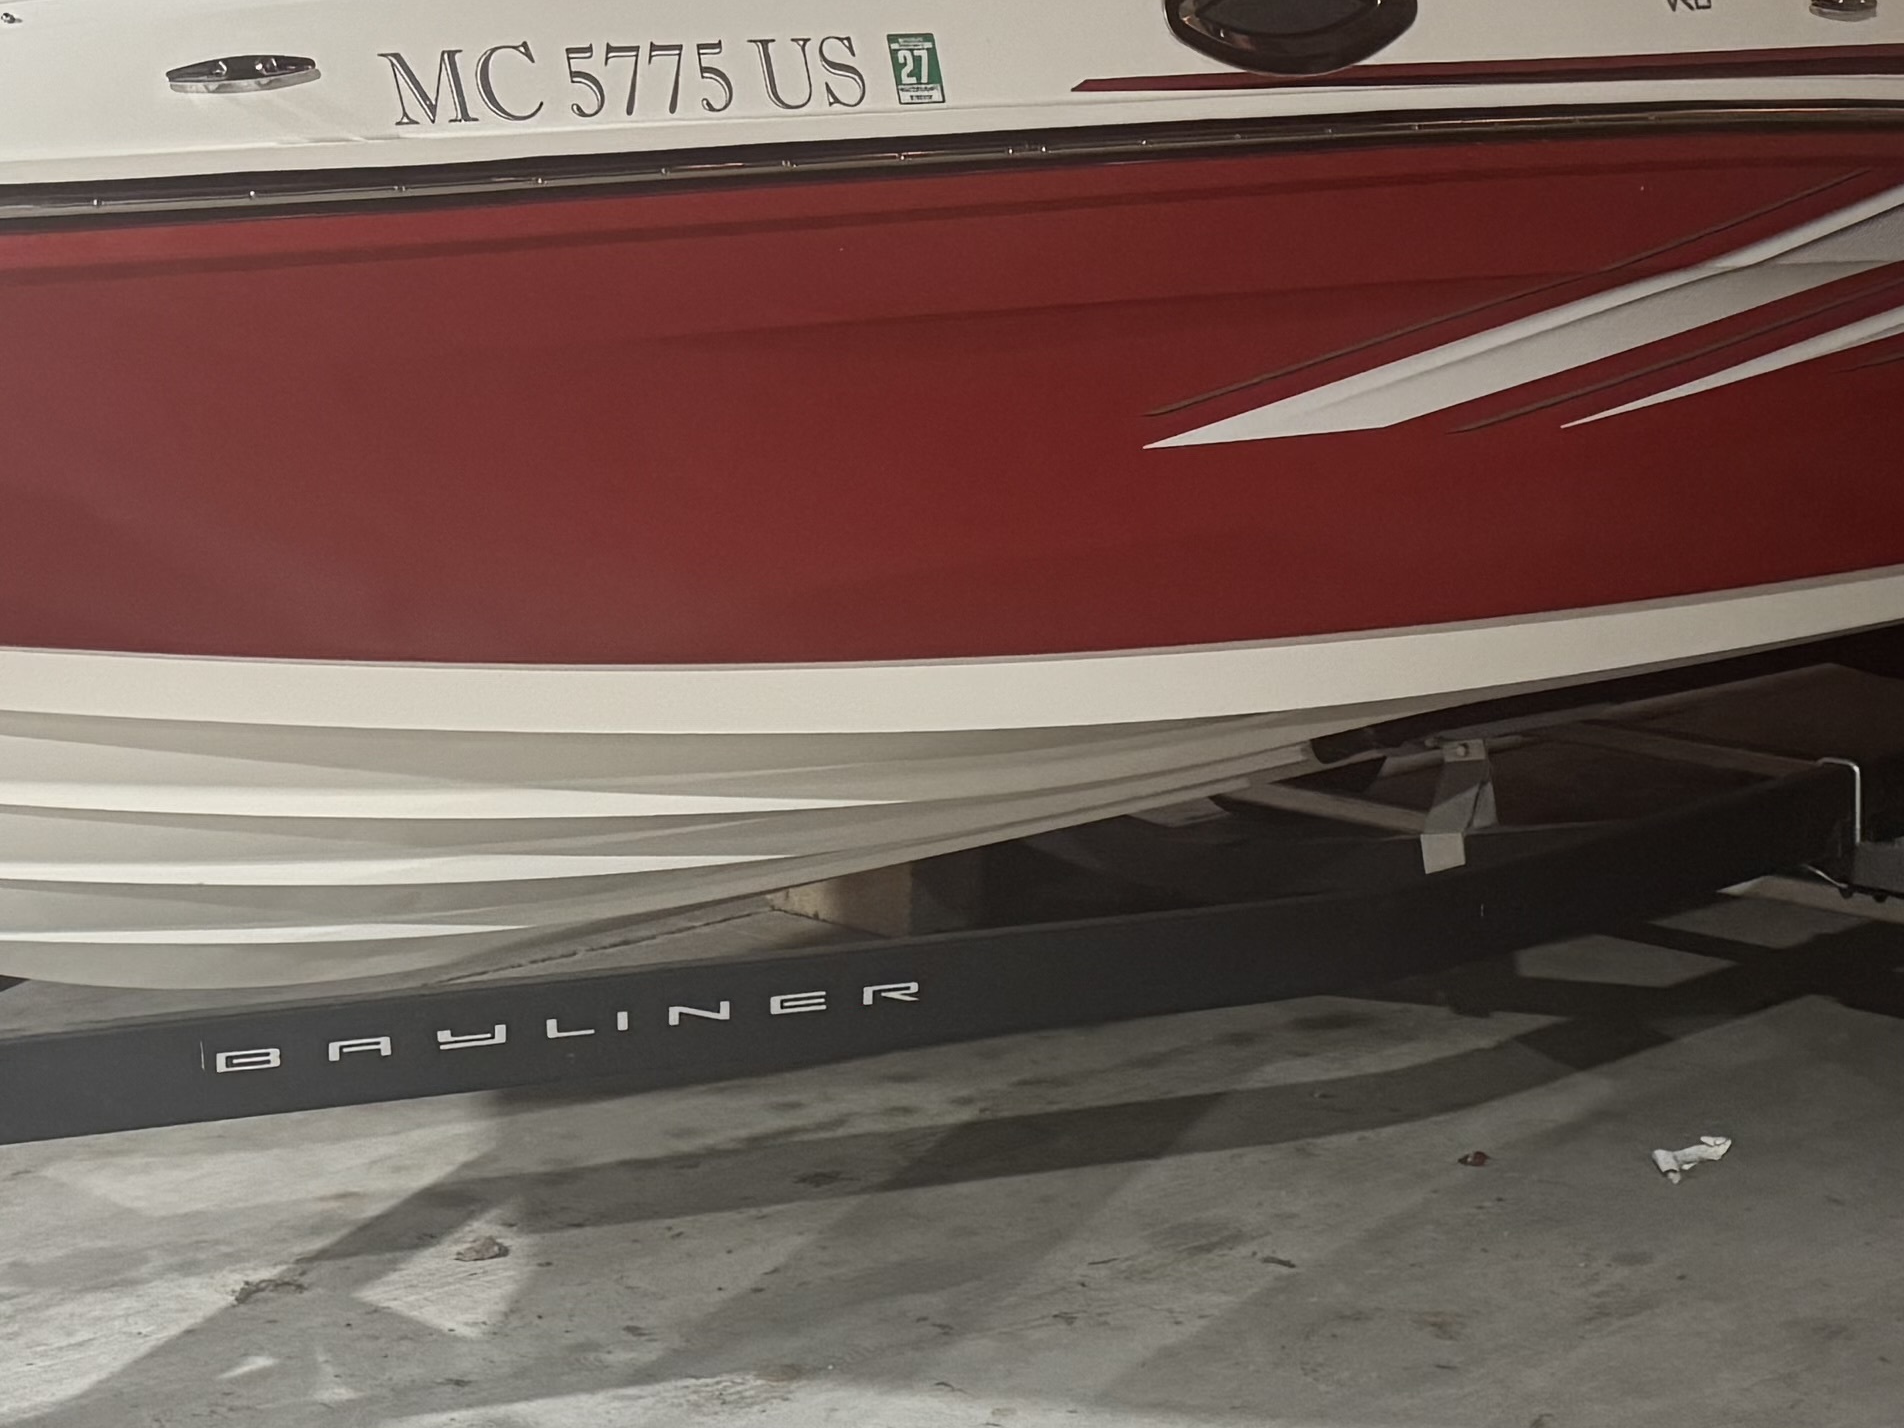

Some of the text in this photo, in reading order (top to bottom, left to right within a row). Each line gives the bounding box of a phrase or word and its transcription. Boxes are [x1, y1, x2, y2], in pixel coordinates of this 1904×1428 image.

[377, 36, 928, 125] MC 5775 US 27
[215, 982, 921, 1073] BAYLINER
